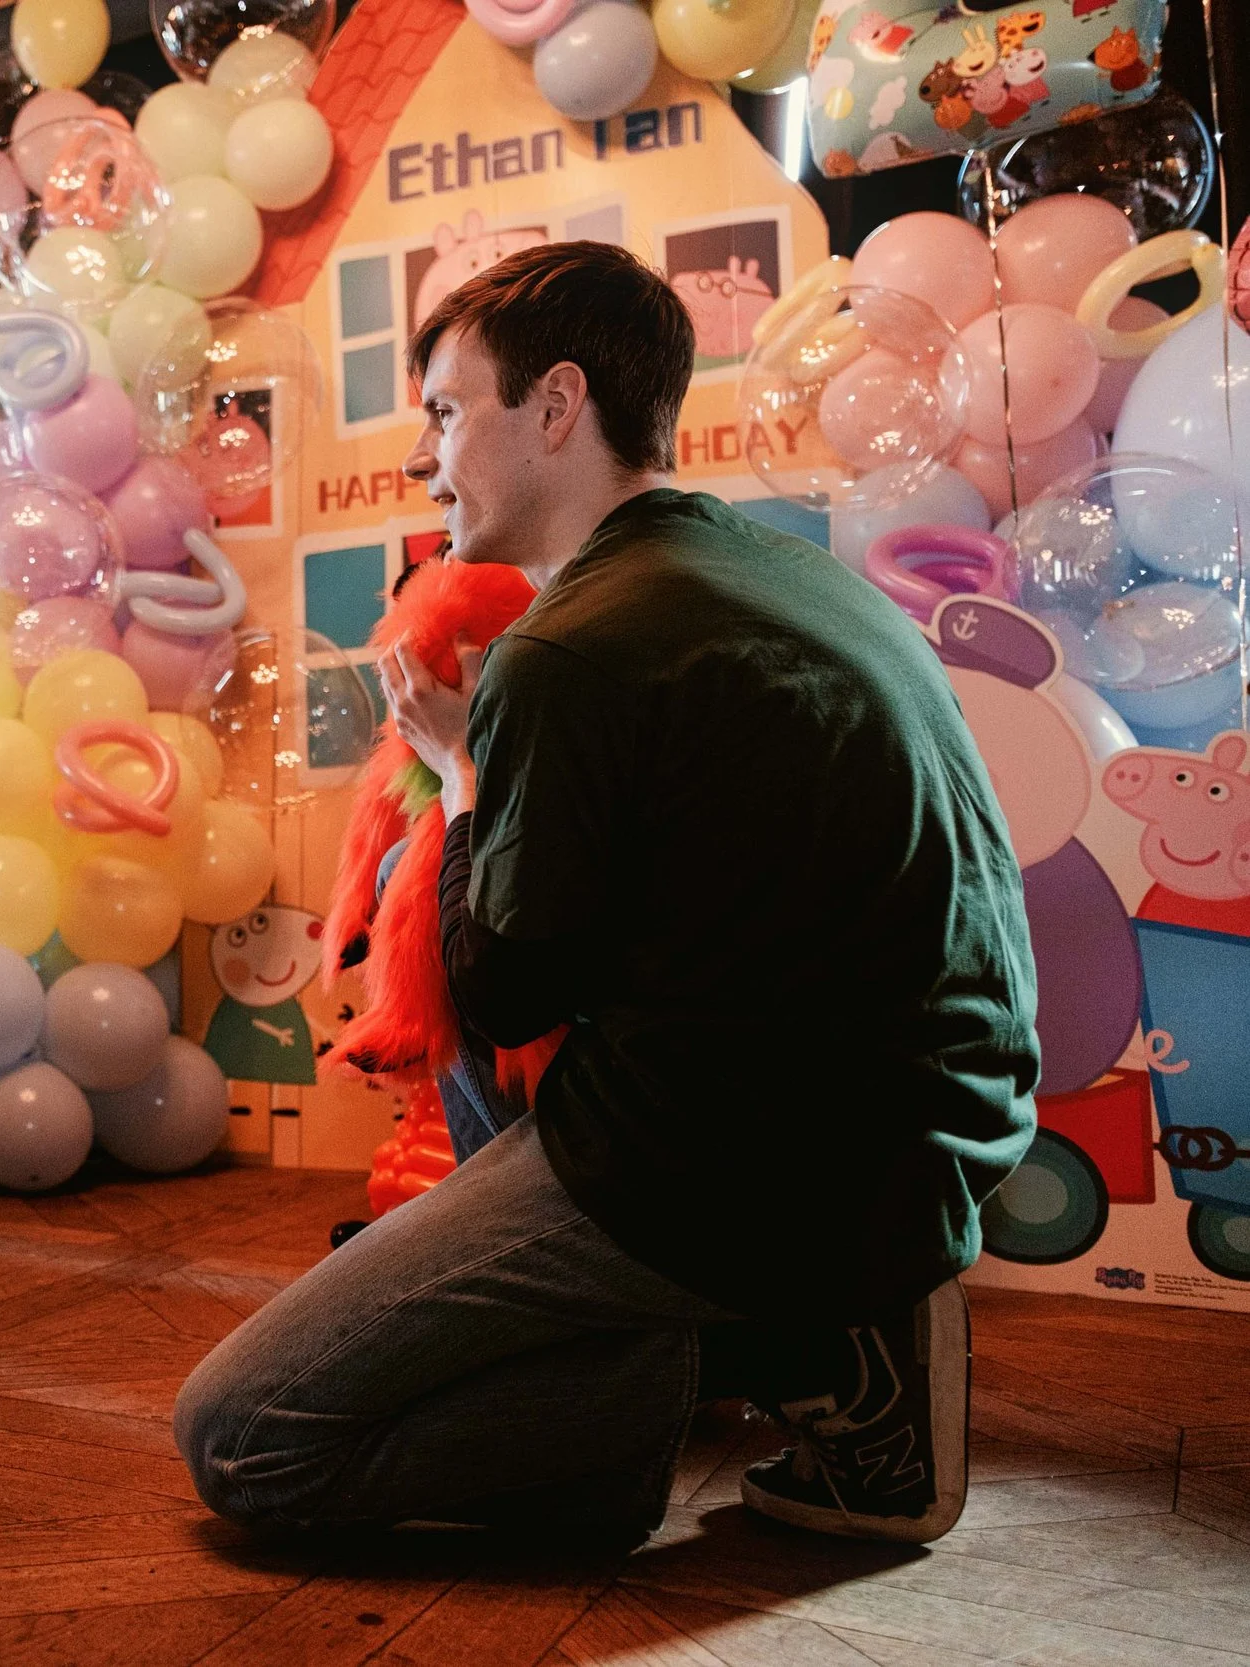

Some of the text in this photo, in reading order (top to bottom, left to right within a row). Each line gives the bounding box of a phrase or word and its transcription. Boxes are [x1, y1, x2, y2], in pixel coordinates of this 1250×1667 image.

[388, 131, 564, 203] Ethan
[318, 415, 810, 513] HAPP HDAY
